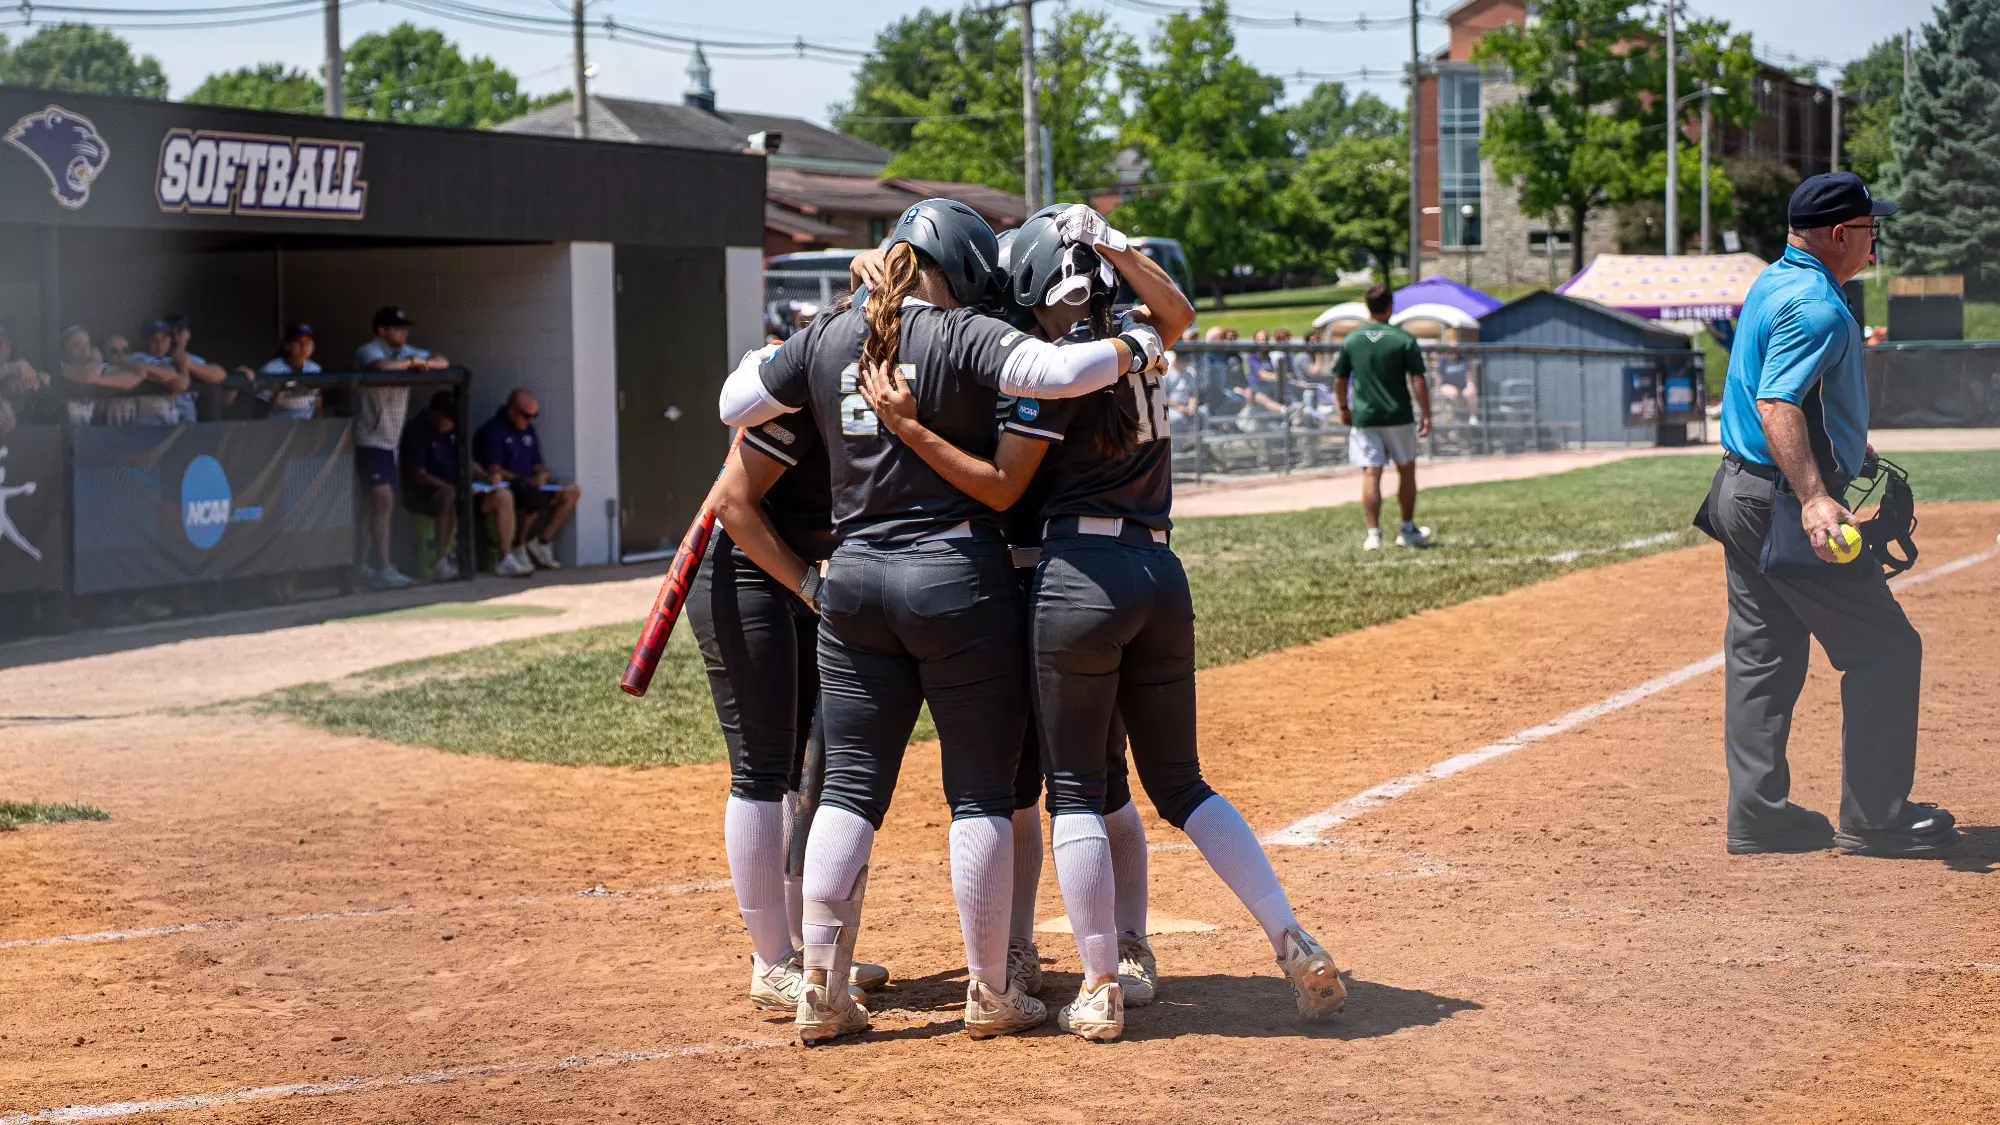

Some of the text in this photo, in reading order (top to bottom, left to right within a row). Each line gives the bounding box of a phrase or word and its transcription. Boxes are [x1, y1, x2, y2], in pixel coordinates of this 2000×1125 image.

[158, 136, 364, 211] SOFTBALL
[1018, 405, 1038, 417] NCAA
[186, 499, 230, 527] NCAA
